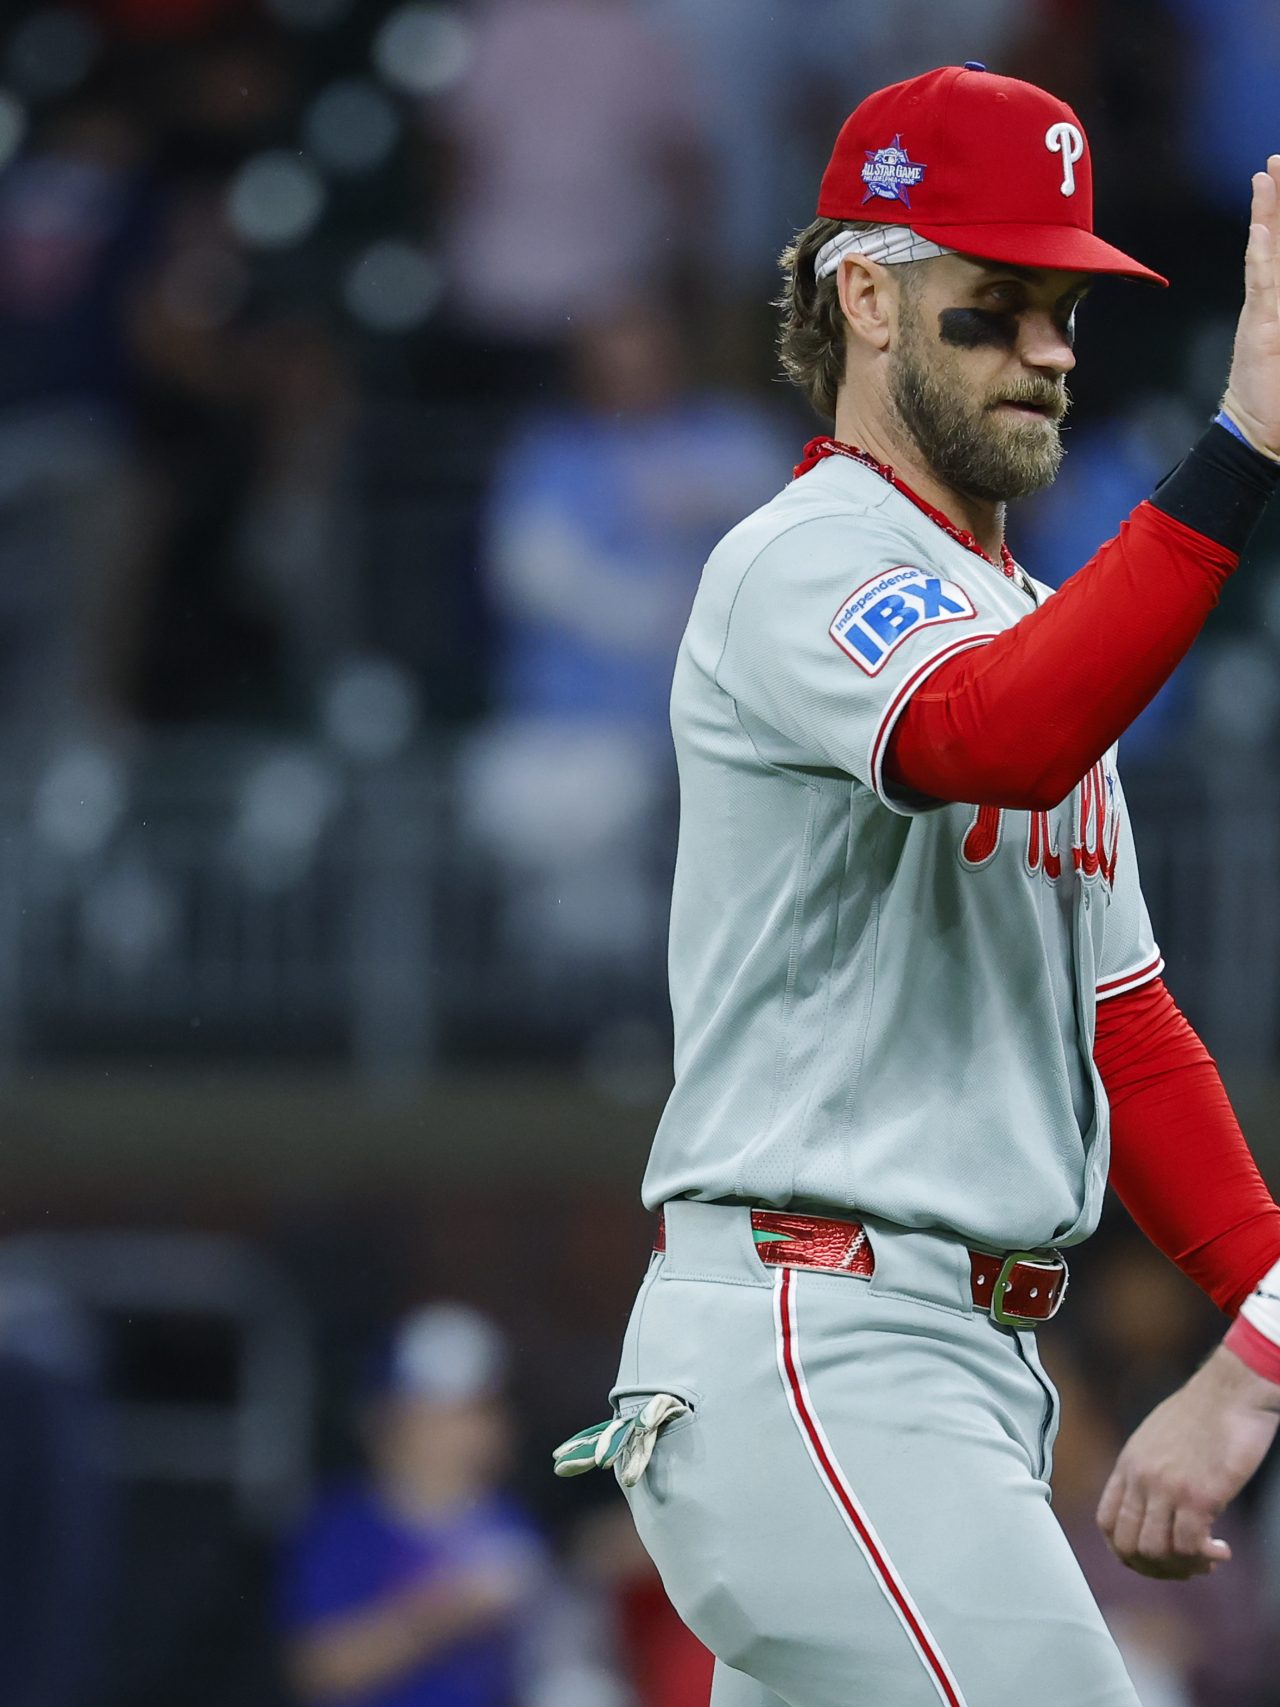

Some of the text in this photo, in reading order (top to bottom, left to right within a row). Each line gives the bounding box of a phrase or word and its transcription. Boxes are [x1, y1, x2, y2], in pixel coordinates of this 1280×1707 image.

[896, 165, 921, 179] GAME
[1045, 122, 1084, 197] P
[834, 570, 918, 632] Independence
[844, 578, 966, 666] IBX
